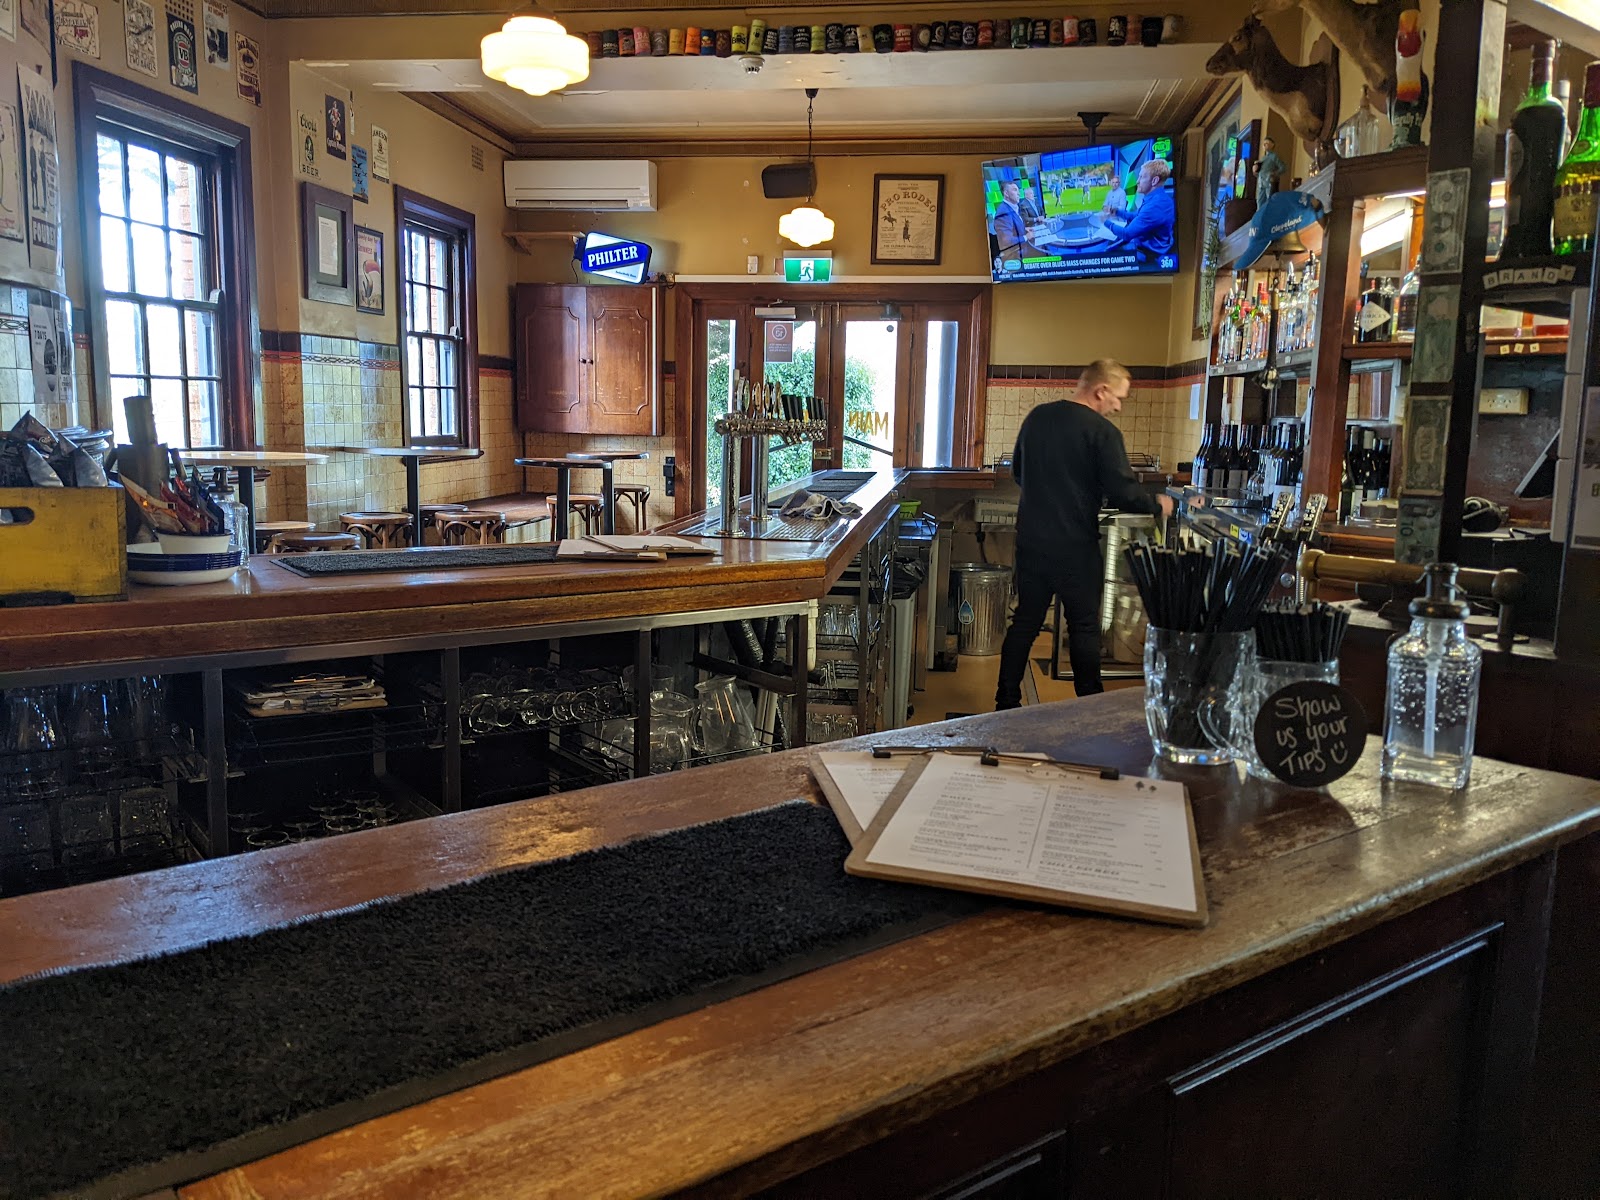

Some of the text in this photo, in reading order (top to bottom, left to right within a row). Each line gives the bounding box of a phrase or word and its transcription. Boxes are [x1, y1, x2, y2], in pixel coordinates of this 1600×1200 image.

[178, 47, 189, 61] VB
[302, 164, 319, 177] BEER
[880, 193, 900, 211] PRO
[902, 191, 937, 213] RODEO
[1271, 215, 1302, 234] Cleveland
[587, 245, 639, 268] PHILTER
[1079, 258, 1100, 266] CHANGES
[1160, 258, 1174, 269] 360
[1487, 267, 1571, 285] BRANDY
[1275, 696, 1341, 726] Show
[1276, 716, 1348, 755] us your
